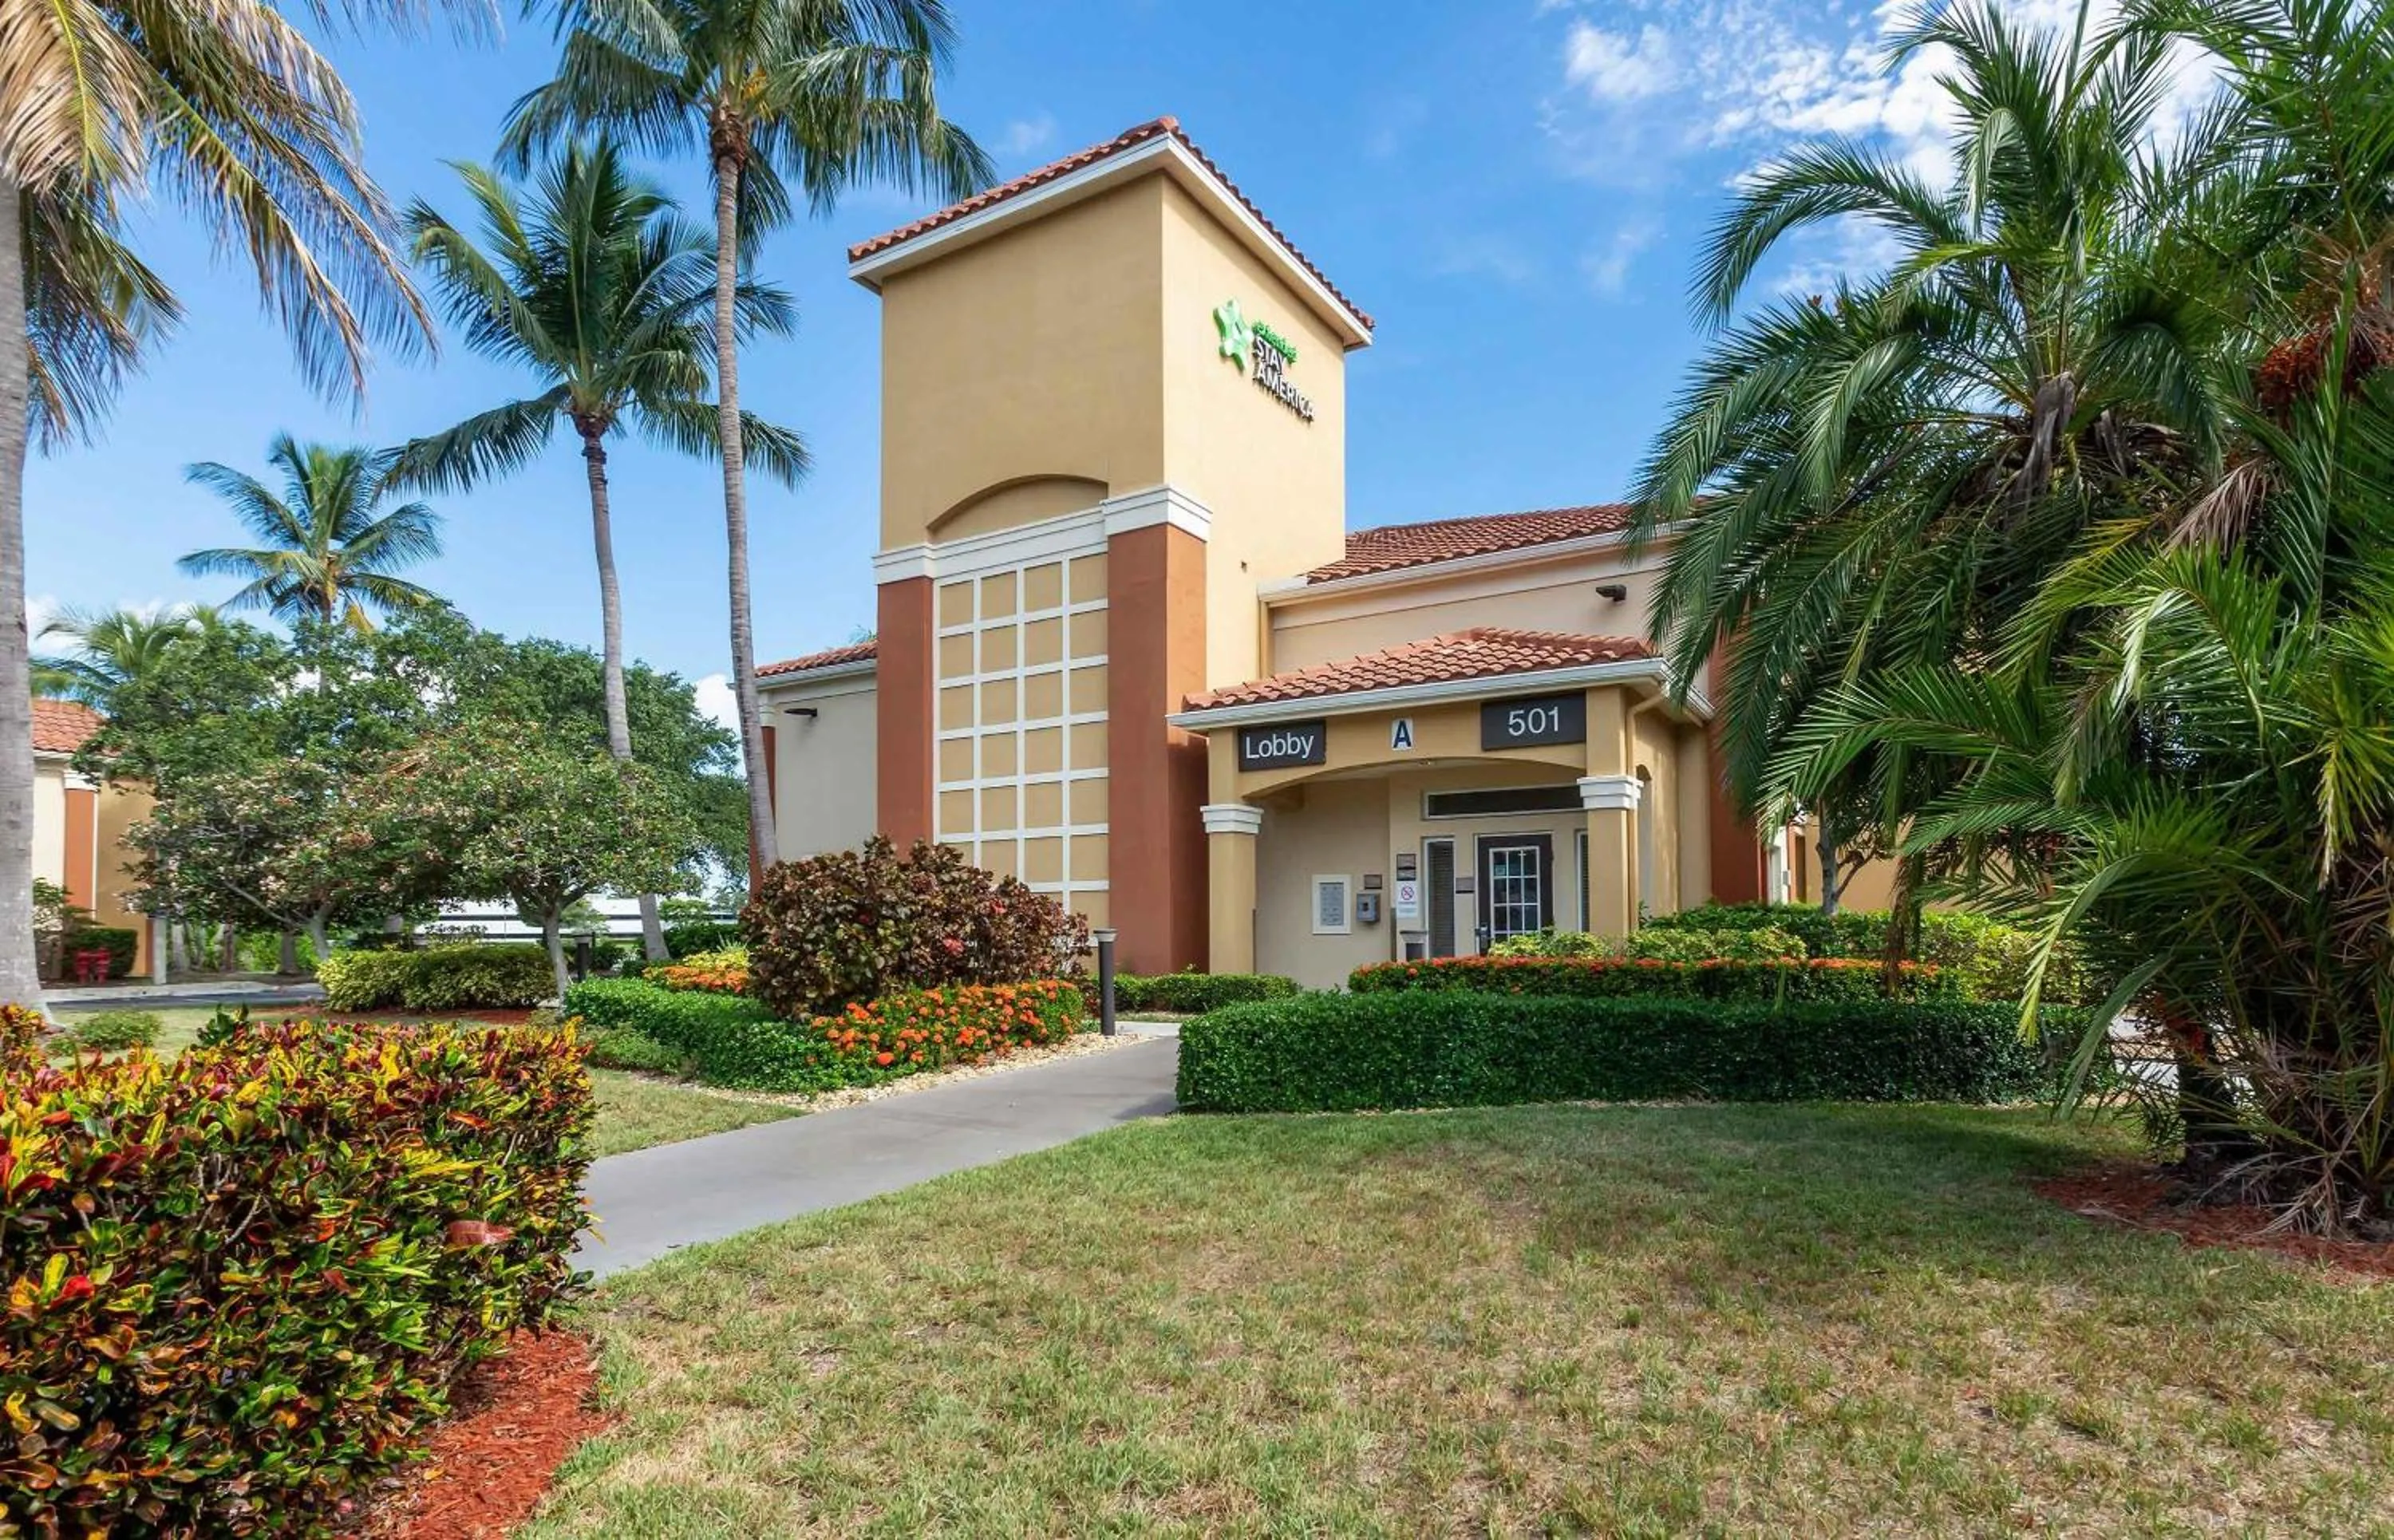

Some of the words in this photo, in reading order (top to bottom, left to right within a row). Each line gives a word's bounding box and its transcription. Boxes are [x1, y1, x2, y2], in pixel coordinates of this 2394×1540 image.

[1254, 335, 1287, 374] STAY
[1257, 359, 1315, 417] AMERICA
[1393, 720, 1412, 748] A
[1507, 706, 1558, 736] 501
[1245, 732, 1314, 759] Lobby
